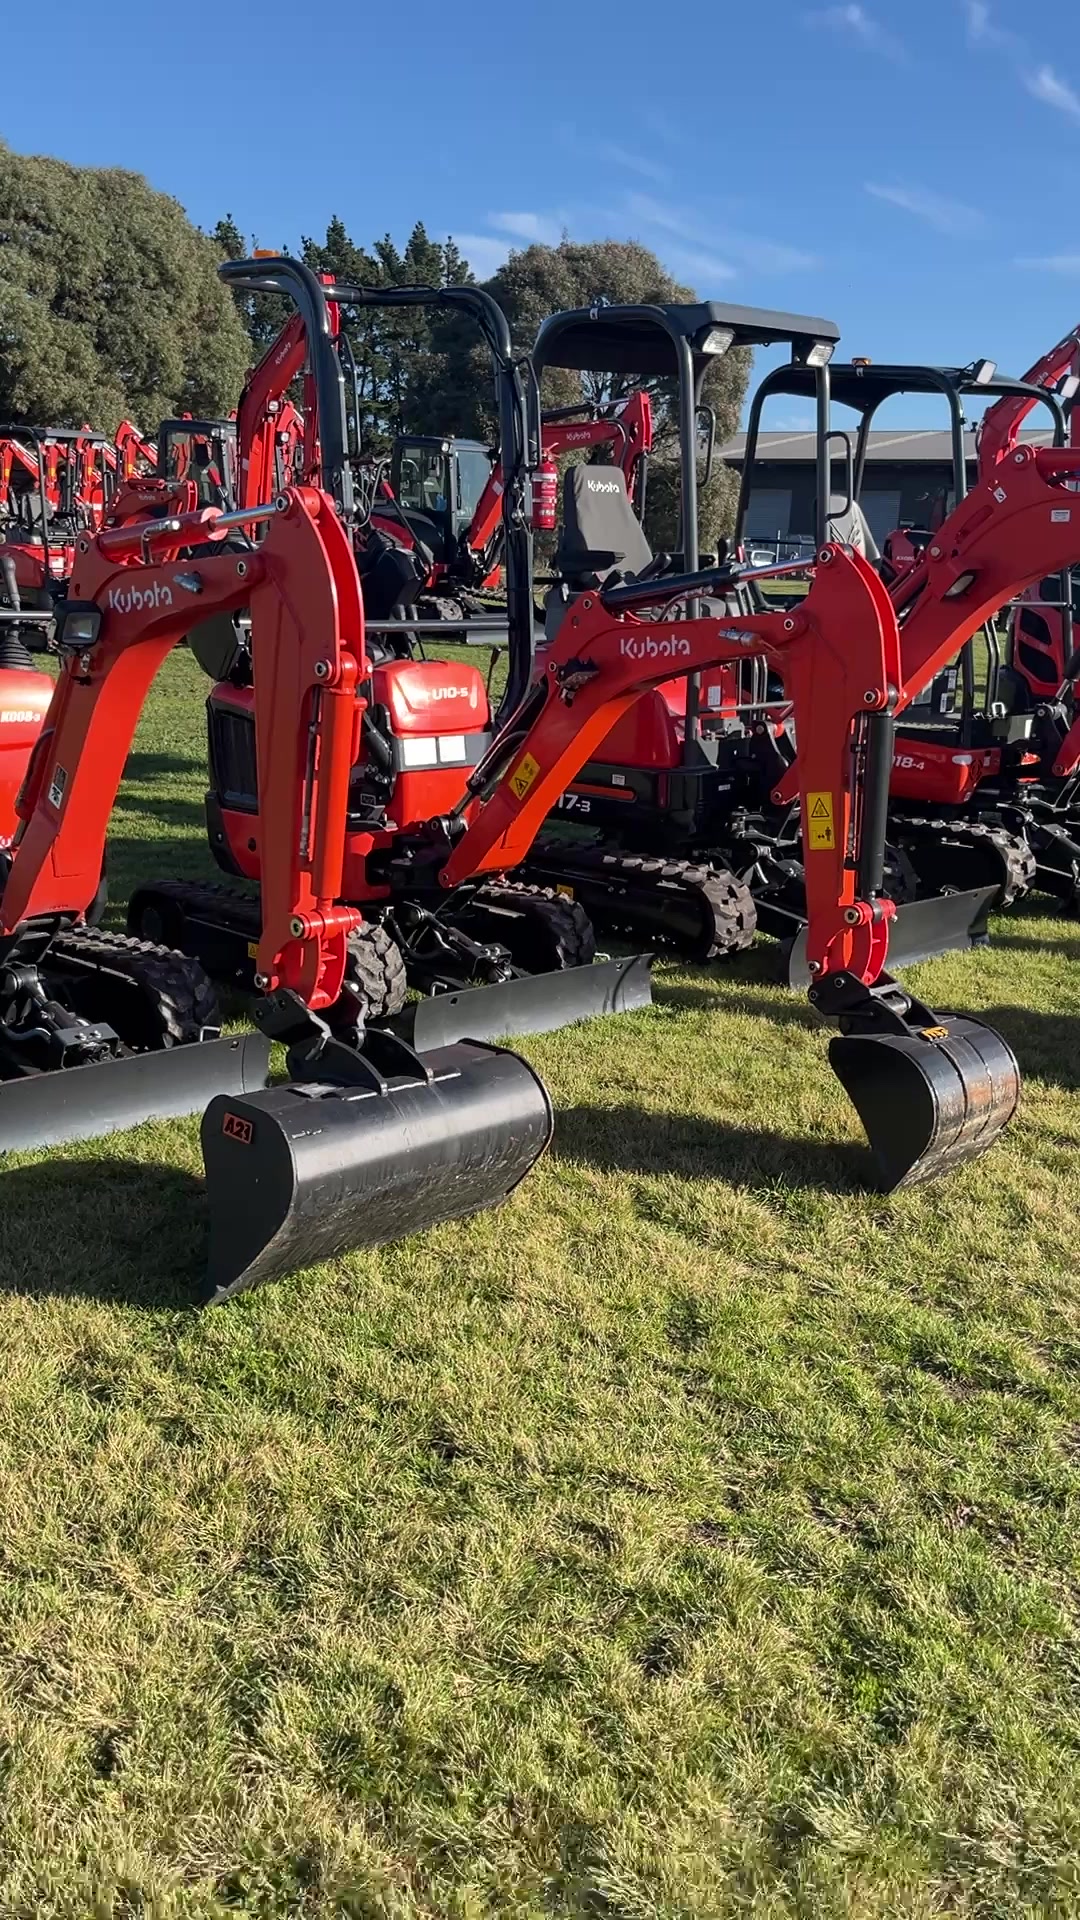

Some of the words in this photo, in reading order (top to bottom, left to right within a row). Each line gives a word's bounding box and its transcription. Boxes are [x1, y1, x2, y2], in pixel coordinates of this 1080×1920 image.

[566, 431, 591, 441] Kubota
[588, 480, 620, 493] Kubota
[109, 580, 173, 613] Kubota
[620, 634, 690, 659] Kubota
[432, 687, 469, 700] U10-5
[893, 755, 925, 770] 18-4
[558, 793, 591, 813] 17-3
